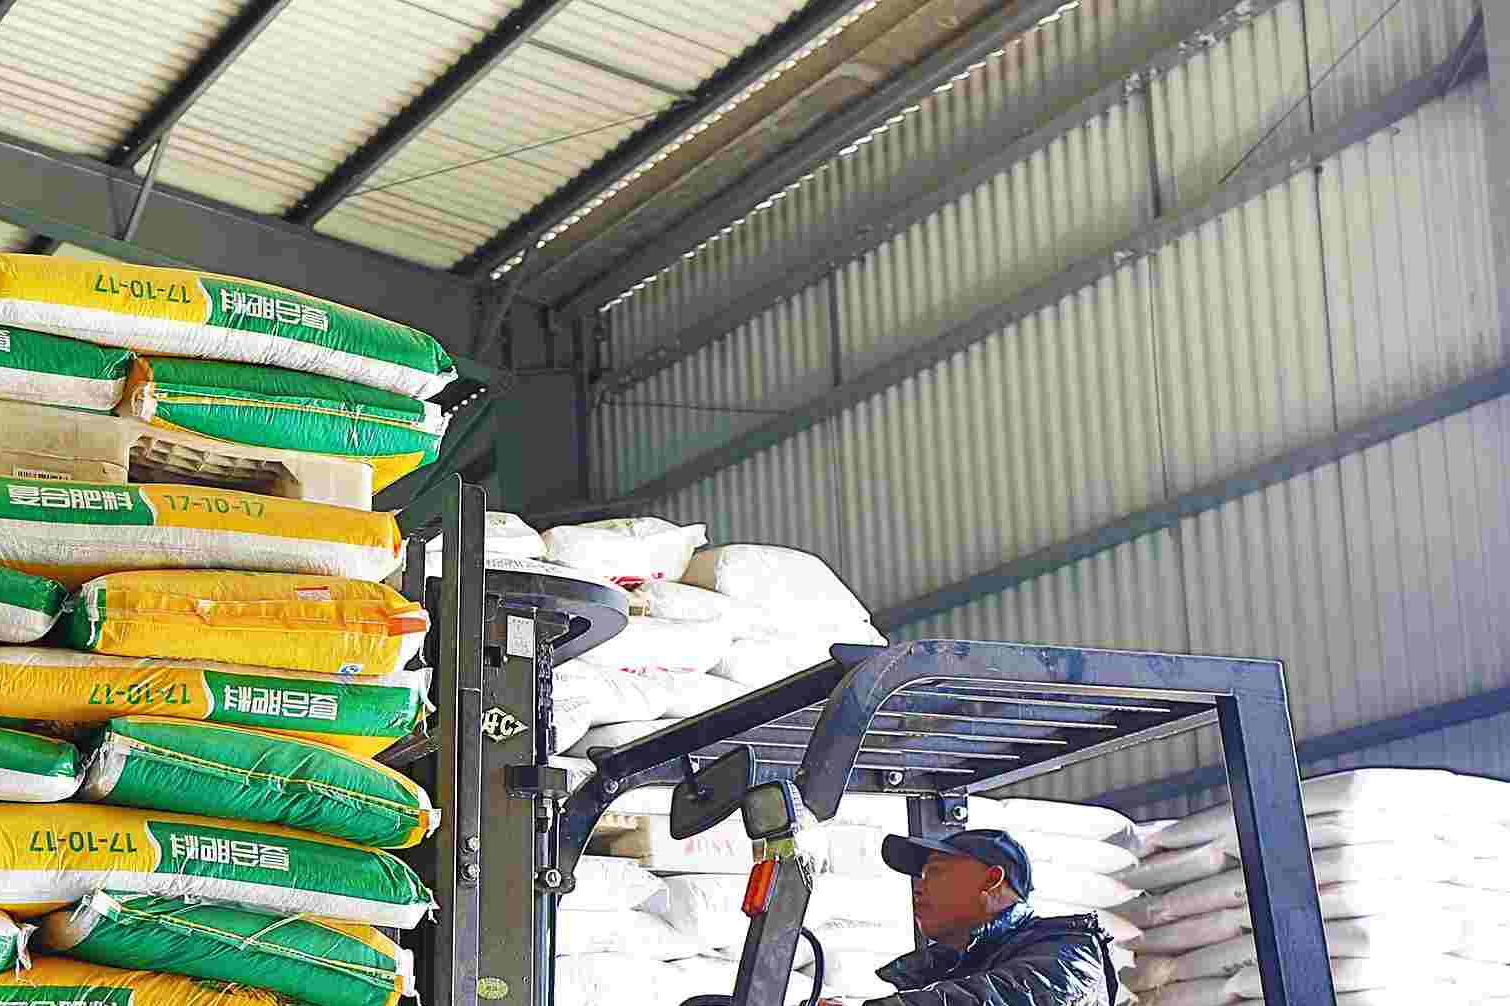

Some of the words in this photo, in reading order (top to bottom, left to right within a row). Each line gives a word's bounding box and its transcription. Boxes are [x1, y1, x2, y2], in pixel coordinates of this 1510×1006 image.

[94, 273, 191, 304] 17-10-17
[220, 288, 329, 331] 复合肥料
[8, 484, 134, 513] 复合肥料
[167, 495, 267, 519] 17-10-17
[89, 682, 192, 706] 17-10-17
[223, 684, 339, 722] 复合肥料
[30, 829, 138, 854] 17-10-17
[170, 832, 290, 872] 复合肥料
